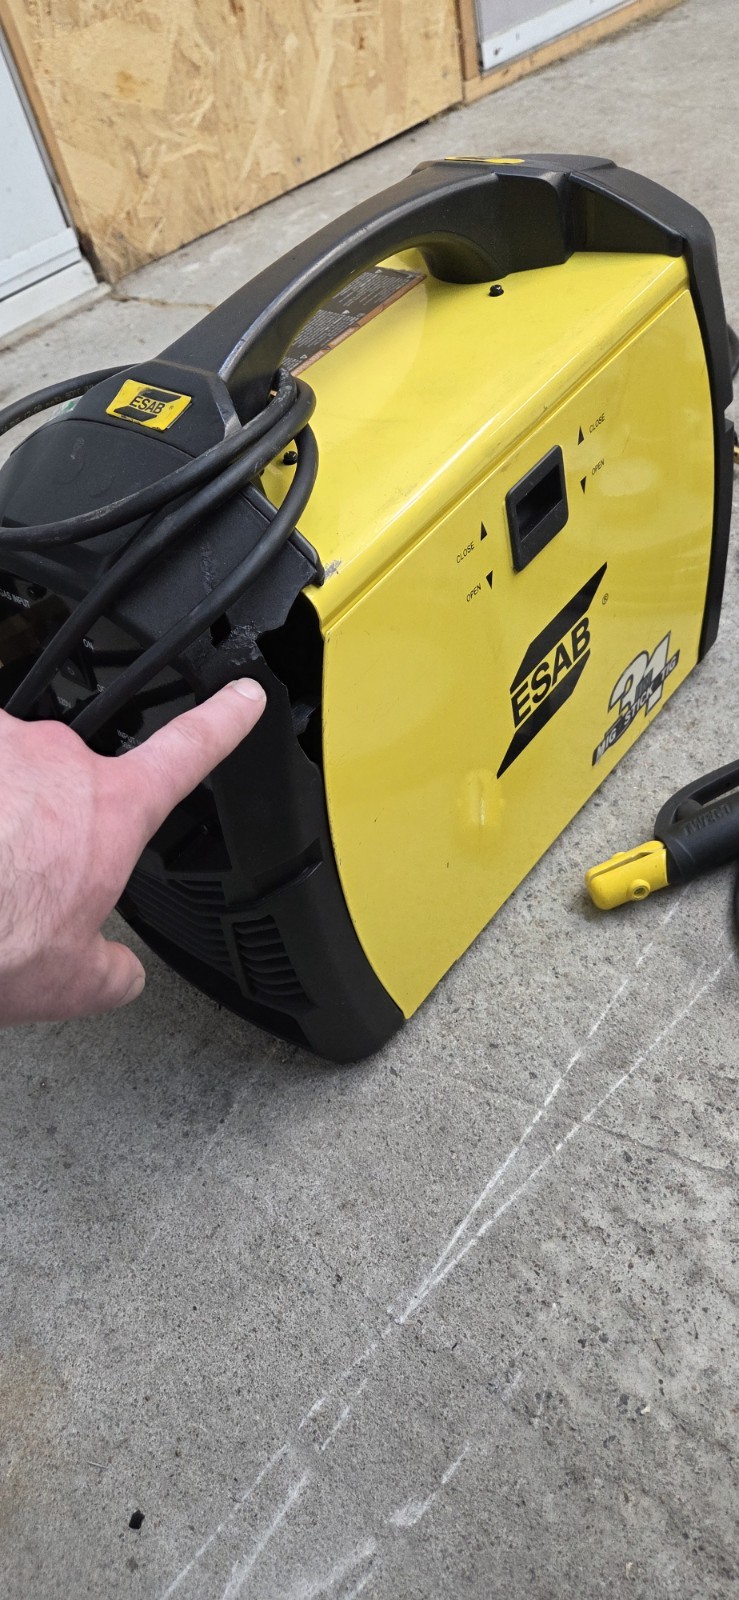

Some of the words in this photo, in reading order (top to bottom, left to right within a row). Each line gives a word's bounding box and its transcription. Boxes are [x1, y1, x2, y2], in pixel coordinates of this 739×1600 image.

[129, 395, 166, 415] ESAB
[588, 412, 606, 434] CLOSE
[591, 458, 605, 476] OPEN
[456, 541, 476, 564] CLOSE
[11, 593, 31, 609] INPUT
[466, 583, 482, 602] OPEN
[82, 638, 95, 651] ON
[510, 616, 591, 729] ESAB
[595, 727, 617, 762] MIG
[624, 682, 654, 726] STICK
[661, 655, 678, 682] TIG
